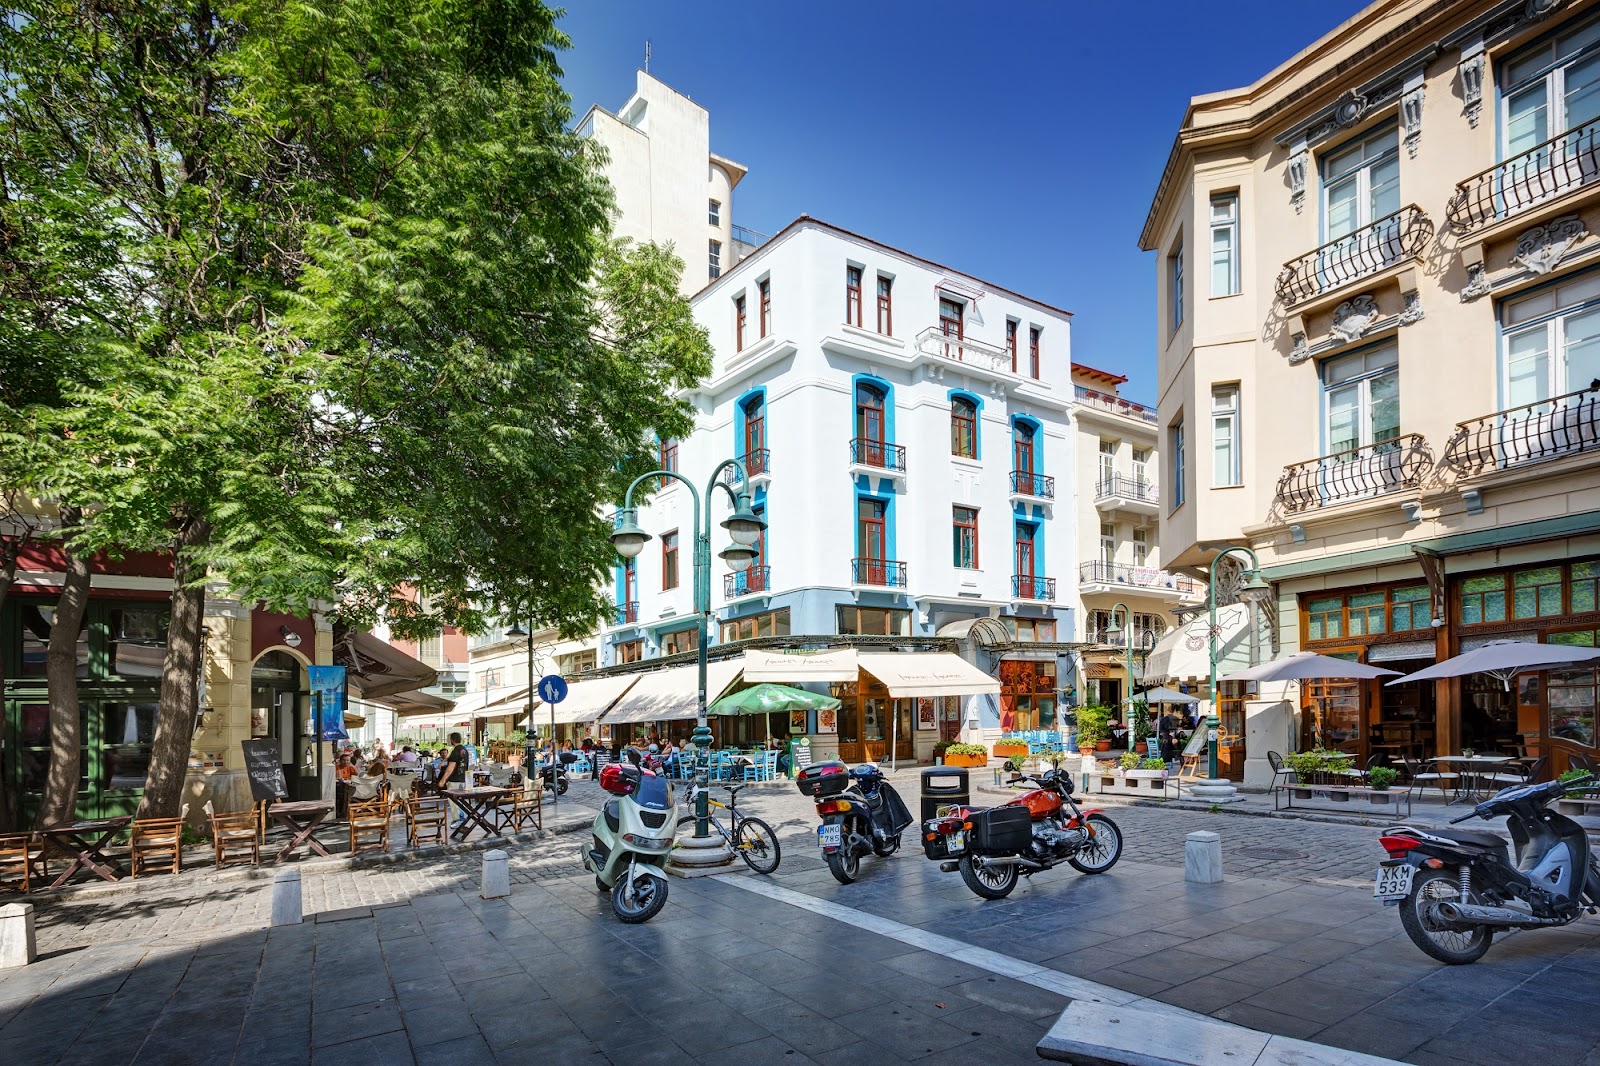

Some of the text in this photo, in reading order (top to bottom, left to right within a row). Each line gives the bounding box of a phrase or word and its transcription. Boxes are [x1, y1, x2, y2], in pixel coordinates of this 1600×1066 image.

[824, 835, 840, 843] 785
[1382, 866, 1410, 881] XKM
[1379, 880, 1407, 894] 539
